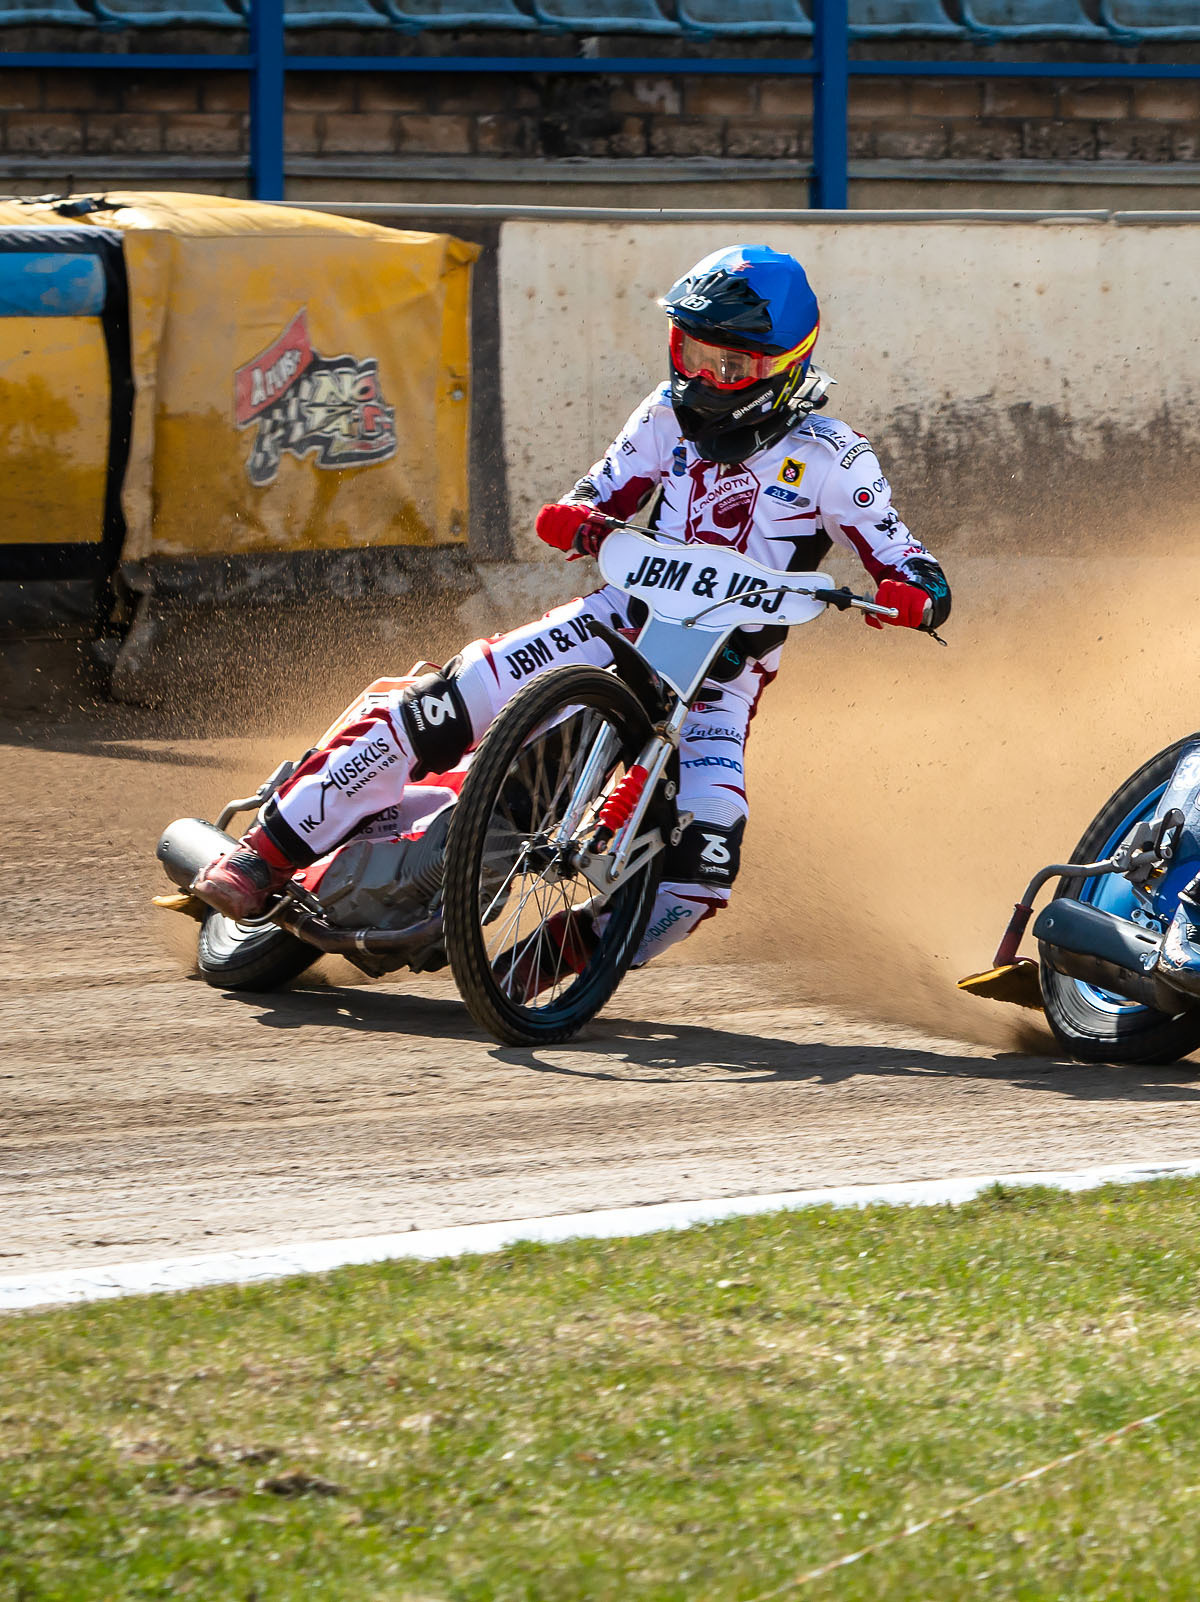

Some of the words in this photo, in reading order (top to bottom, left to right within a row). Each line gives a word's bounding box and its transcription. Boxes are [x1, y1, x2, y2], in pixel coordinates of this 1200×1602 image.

[627, 556, 693, 591] JBM
[692, 566, 719, 598] &
[724, 572, 789, 614] VBJ
[504, 640, 555, 680] JBM
[549, 628, 577, 653] &
[346, 771, 378, 798] ANNO
